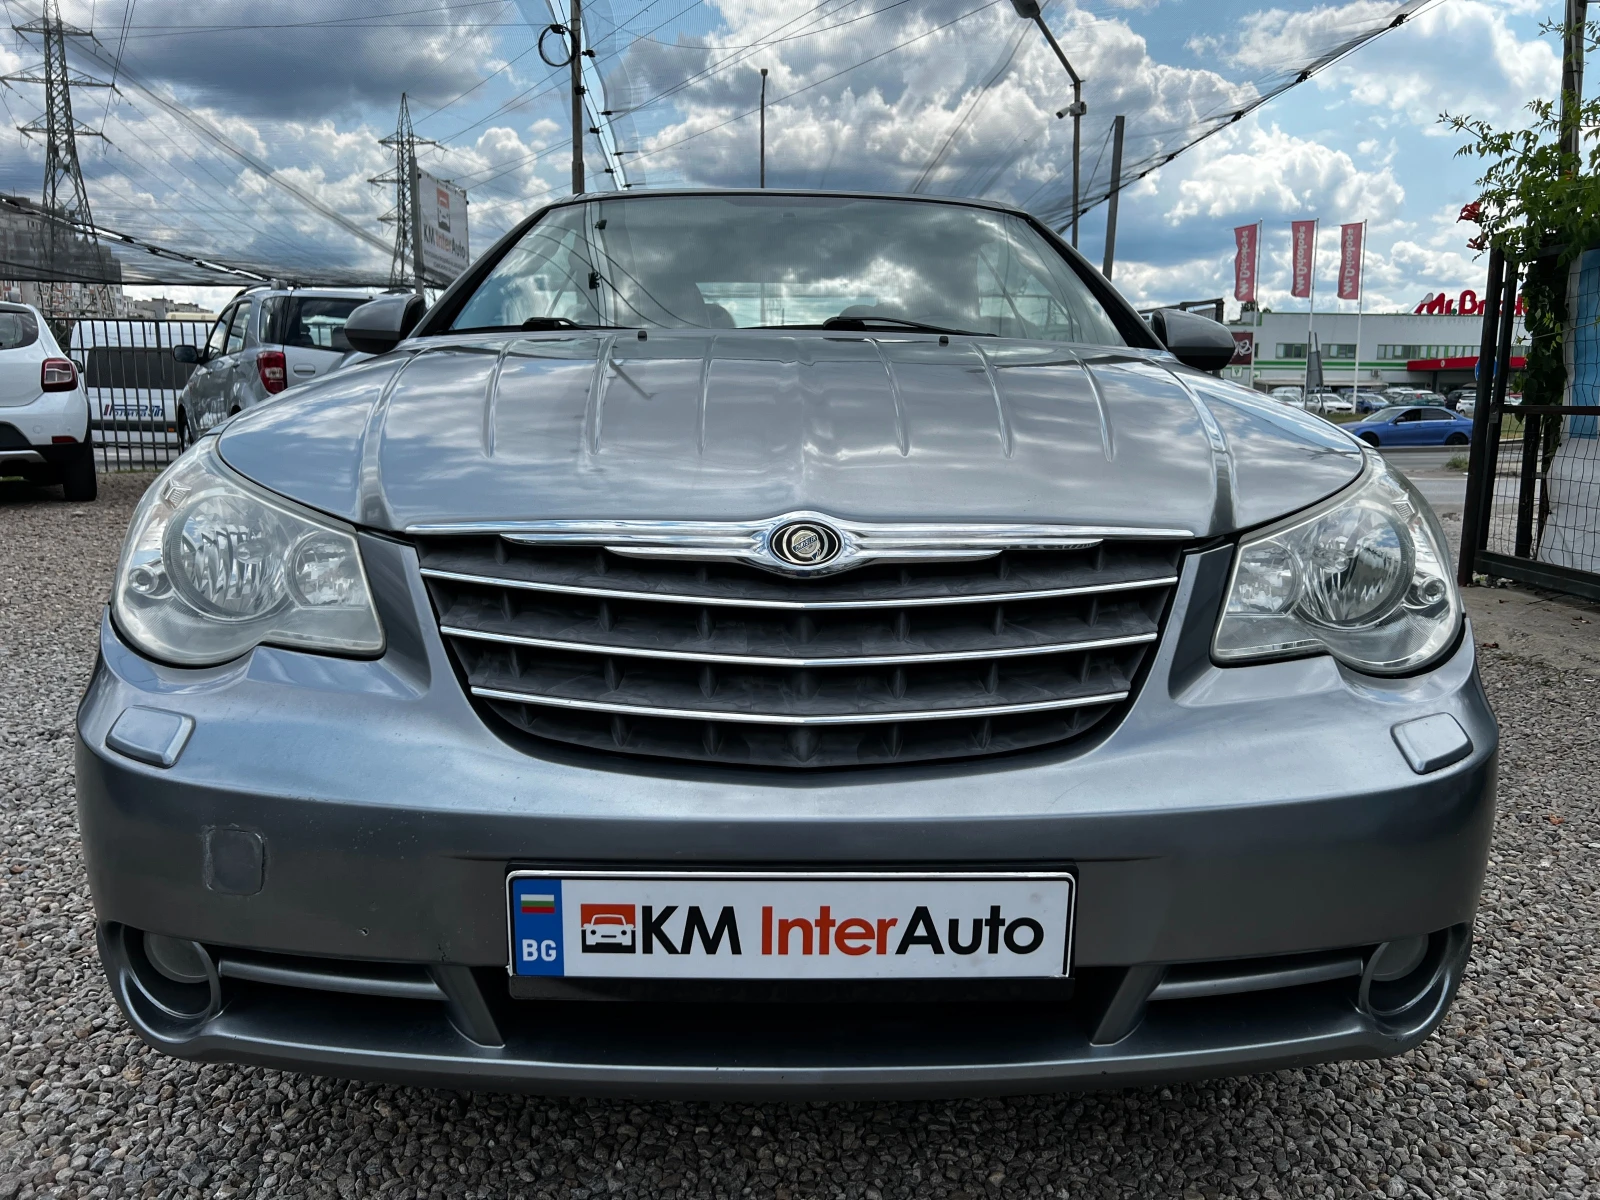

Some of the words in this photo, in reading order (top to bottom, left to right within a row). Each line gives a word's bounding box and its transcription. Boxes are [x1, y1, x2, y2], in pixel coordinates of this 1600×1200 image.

[424, 223, 436, 246] KM
[435, 229, 465, 259] InterAuto
[641, 906, 742, 955] KM
[761, 906, 1045, 956] InterAuto
[522, 939, 557, 962] BG
